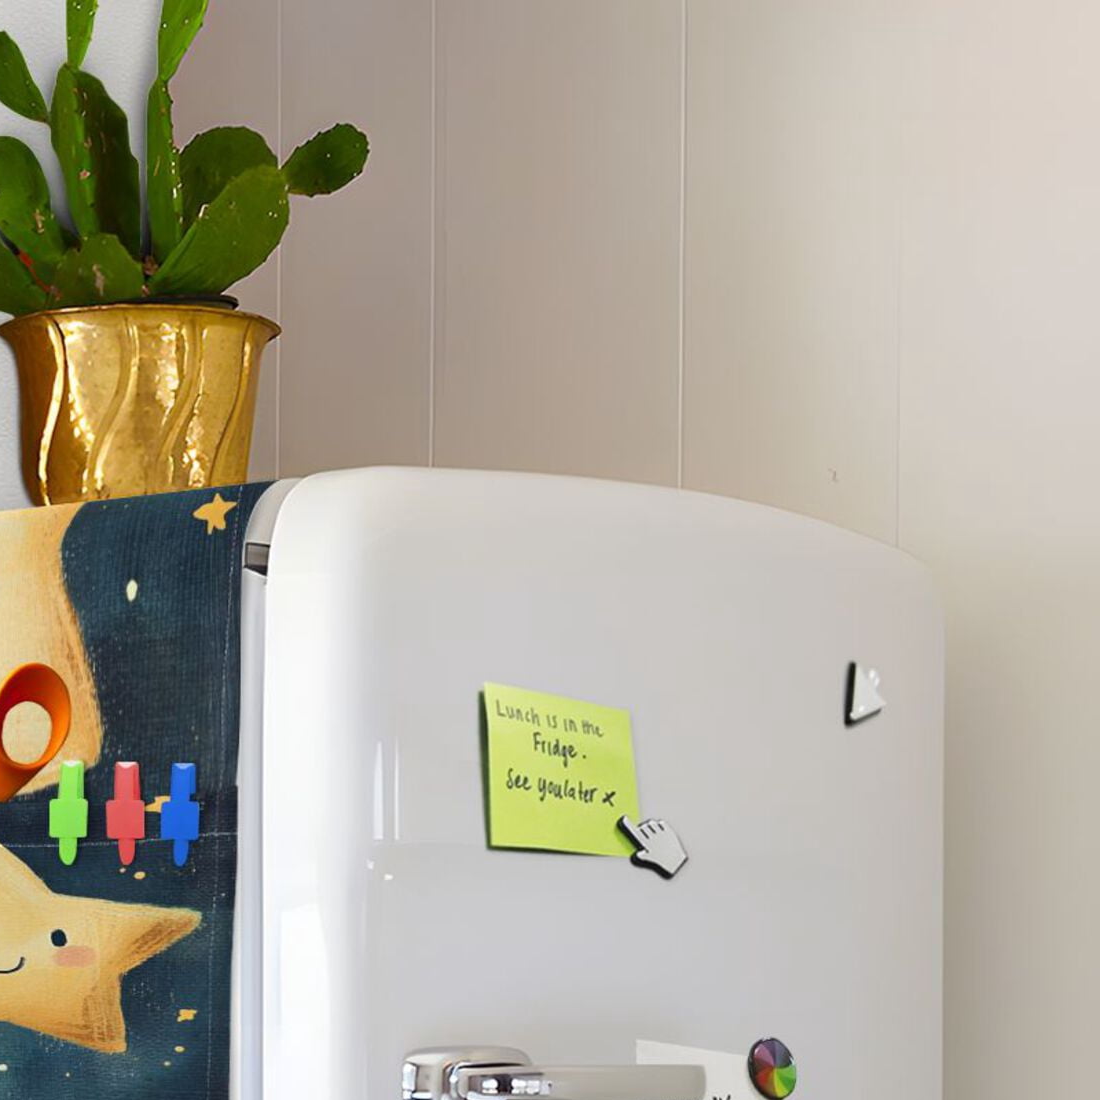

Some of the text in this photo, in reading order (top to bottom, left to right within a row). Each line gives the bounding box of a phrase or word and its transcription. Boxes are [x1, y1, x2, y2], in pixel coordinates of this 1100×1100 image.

[496, 699, 604, 738] Lunch is in the
[506, 768, 531, 791] See
